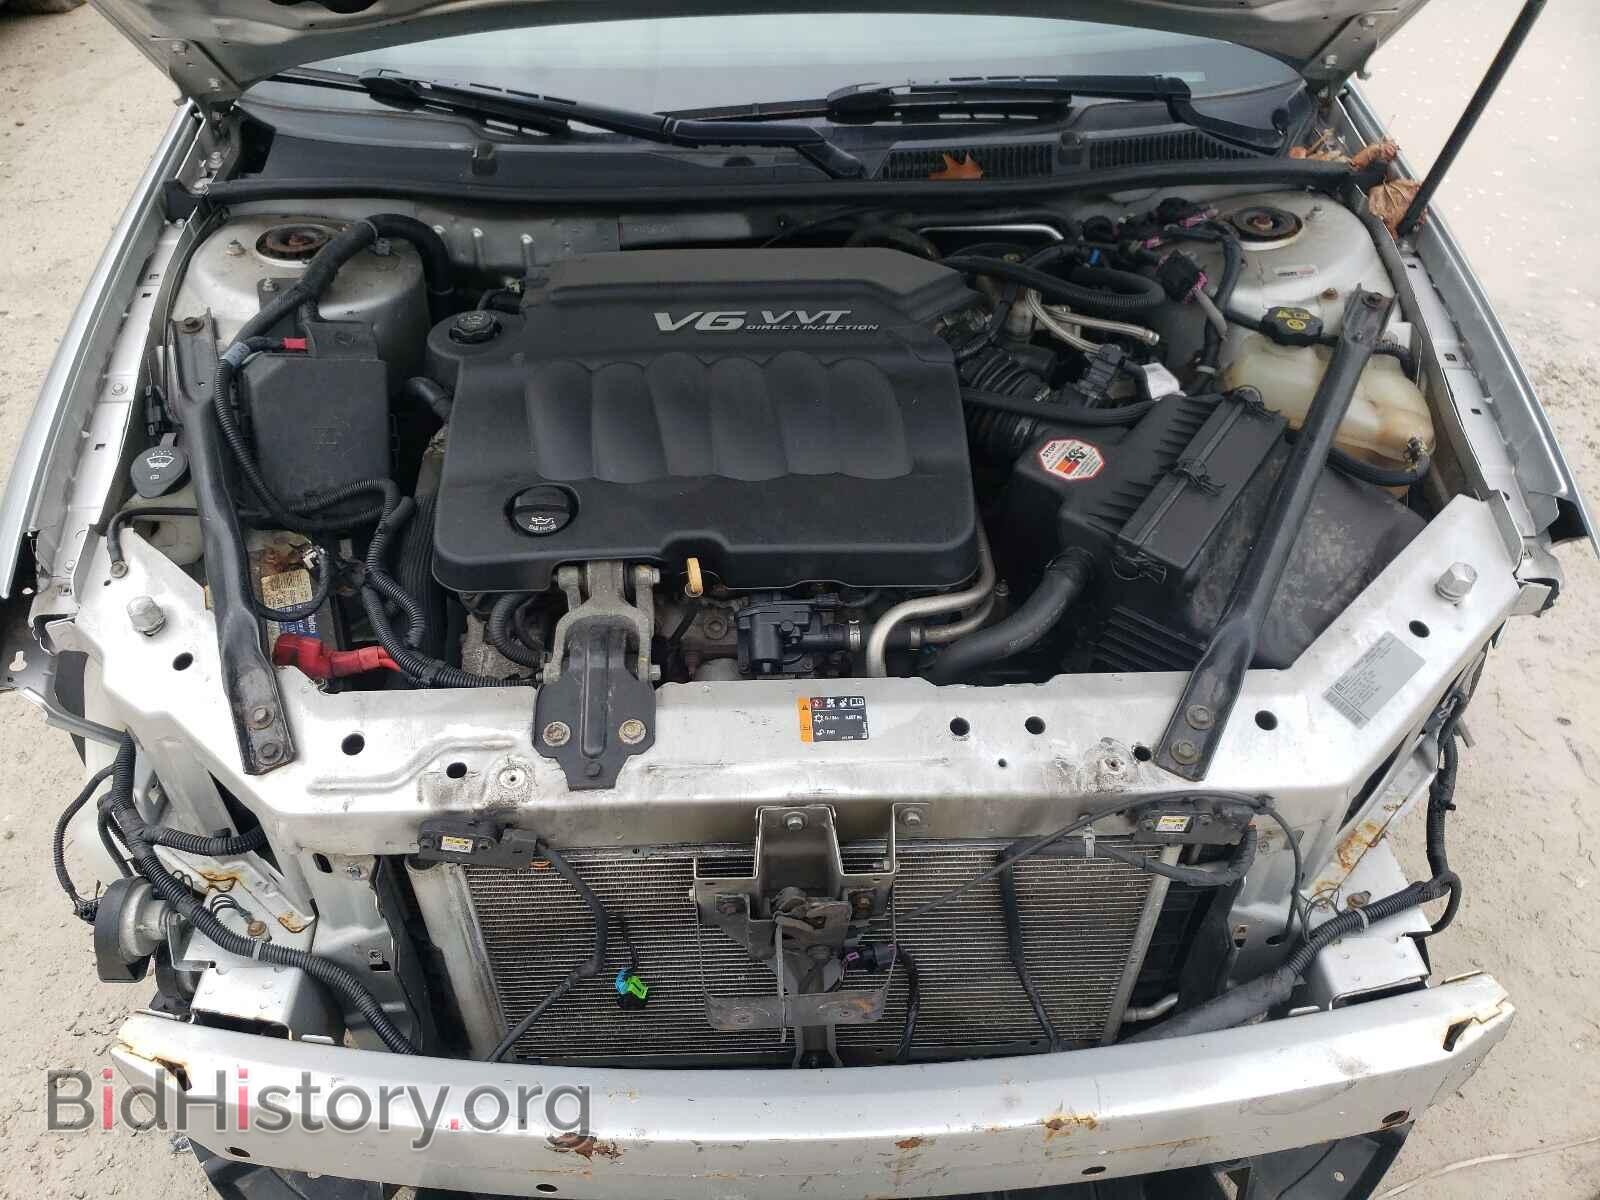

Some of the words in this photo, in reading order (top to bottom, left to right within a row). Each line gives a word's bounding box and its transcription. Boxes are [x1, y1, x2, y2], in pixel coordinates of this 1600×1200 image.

[654, 311, 747, 331] V6
[760, 310, 852, 324] VVT
[746, 323, 800, 331] DIRECT
[802, 323, 879, 331] INJECTION
